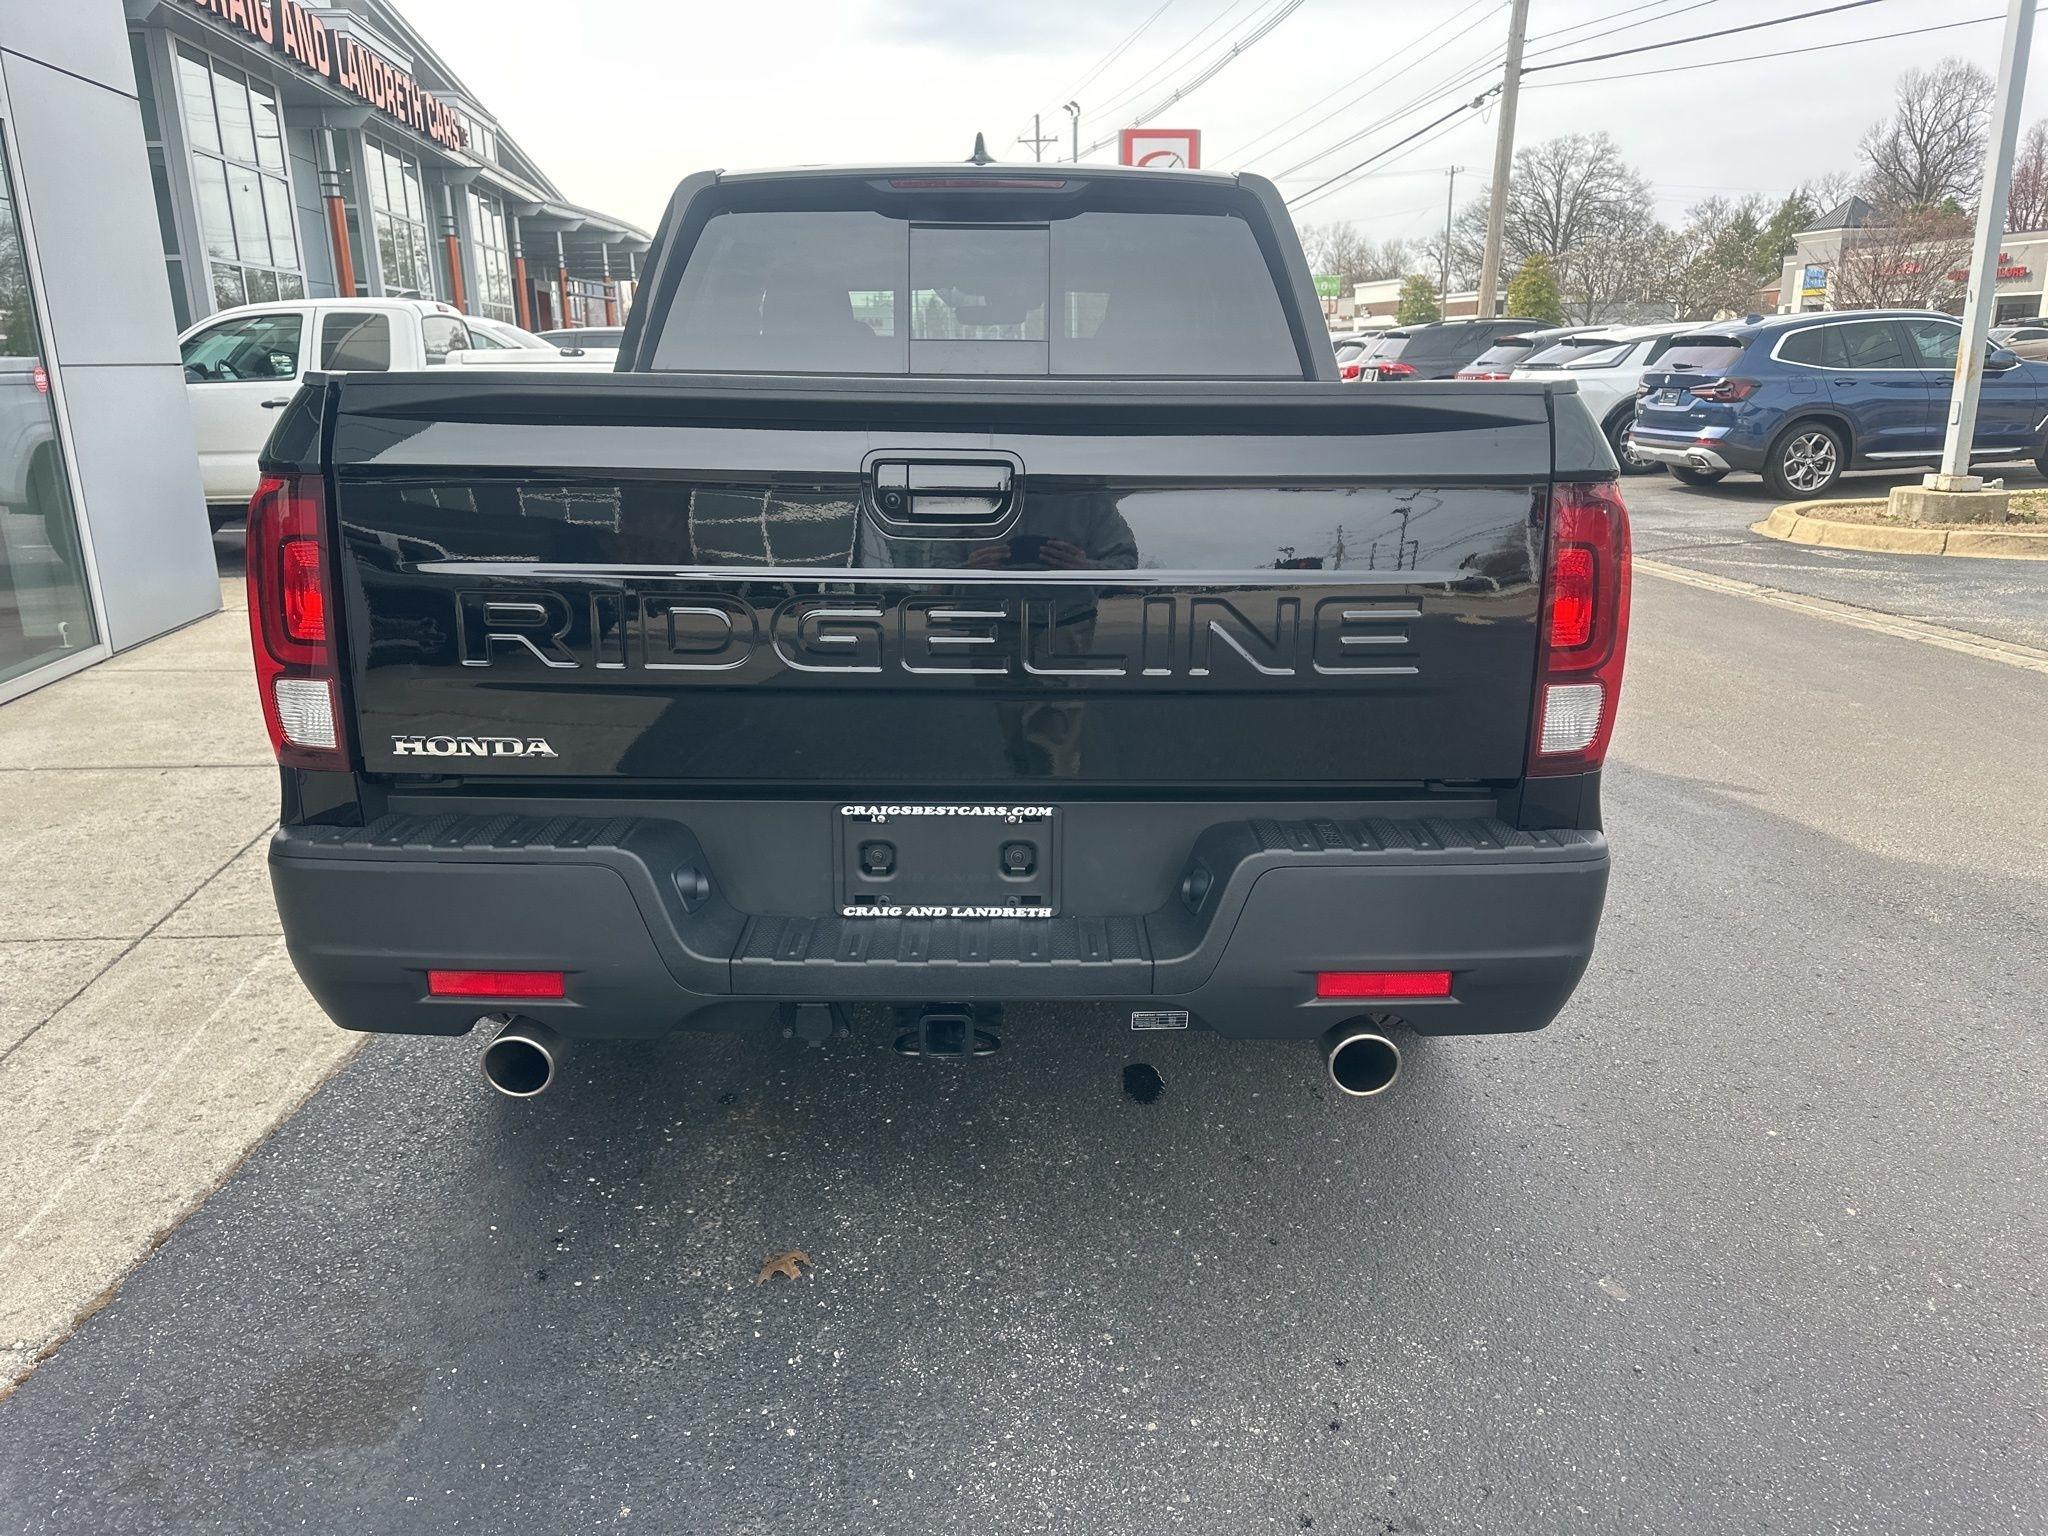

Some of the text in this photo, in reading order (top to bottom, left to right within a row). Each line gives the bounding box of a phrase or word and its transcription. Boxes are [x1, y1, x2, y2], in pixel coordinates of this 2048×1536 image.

[281, 0, 330, 77] AND
[334, 29, 424, 132] LANDRETH
[426, 92, 460, 151] CARS
[454, 588, 1425, 675] RIDGELINE
[391, 735, 559, 757] HONDA
[840, 805, 1054, 816] CRAIGSBESTCARS.COM
[843, 906, 1052, 918] CRAIG AND LANDRETH
